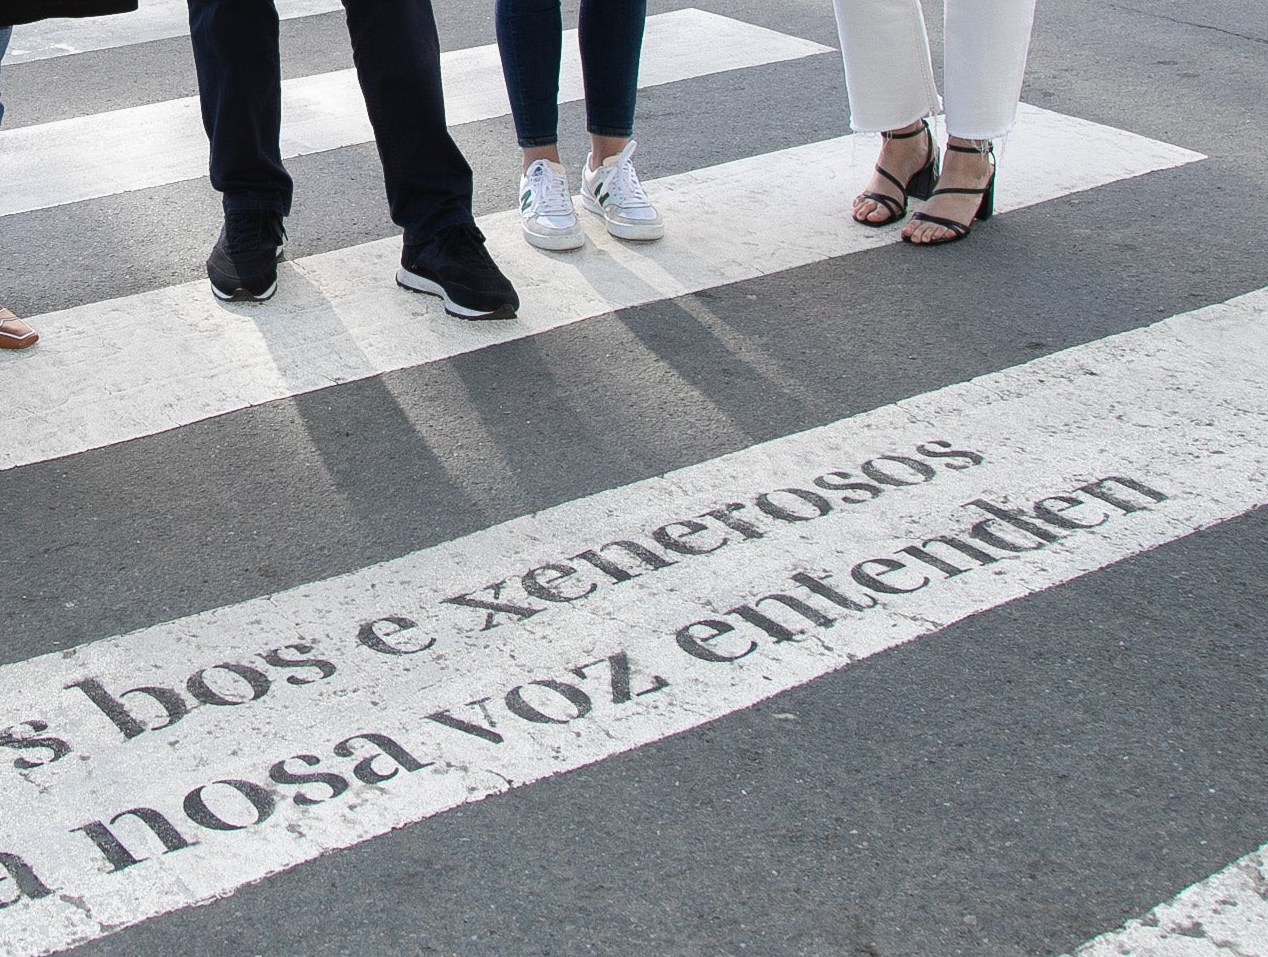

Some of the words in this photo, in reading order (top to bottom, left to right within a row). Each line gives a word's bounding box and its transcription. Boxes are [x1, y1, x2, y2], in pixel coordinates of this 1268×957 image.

[63, 642, 337, 741] bos
[355, 614, 437, 655] e
[439, 438, 985, 632] xenerosos
[69, 731, 434, 875] nosa
[424, 650, 670, 746] voz
[674, 473, 1169, 664] entenden
